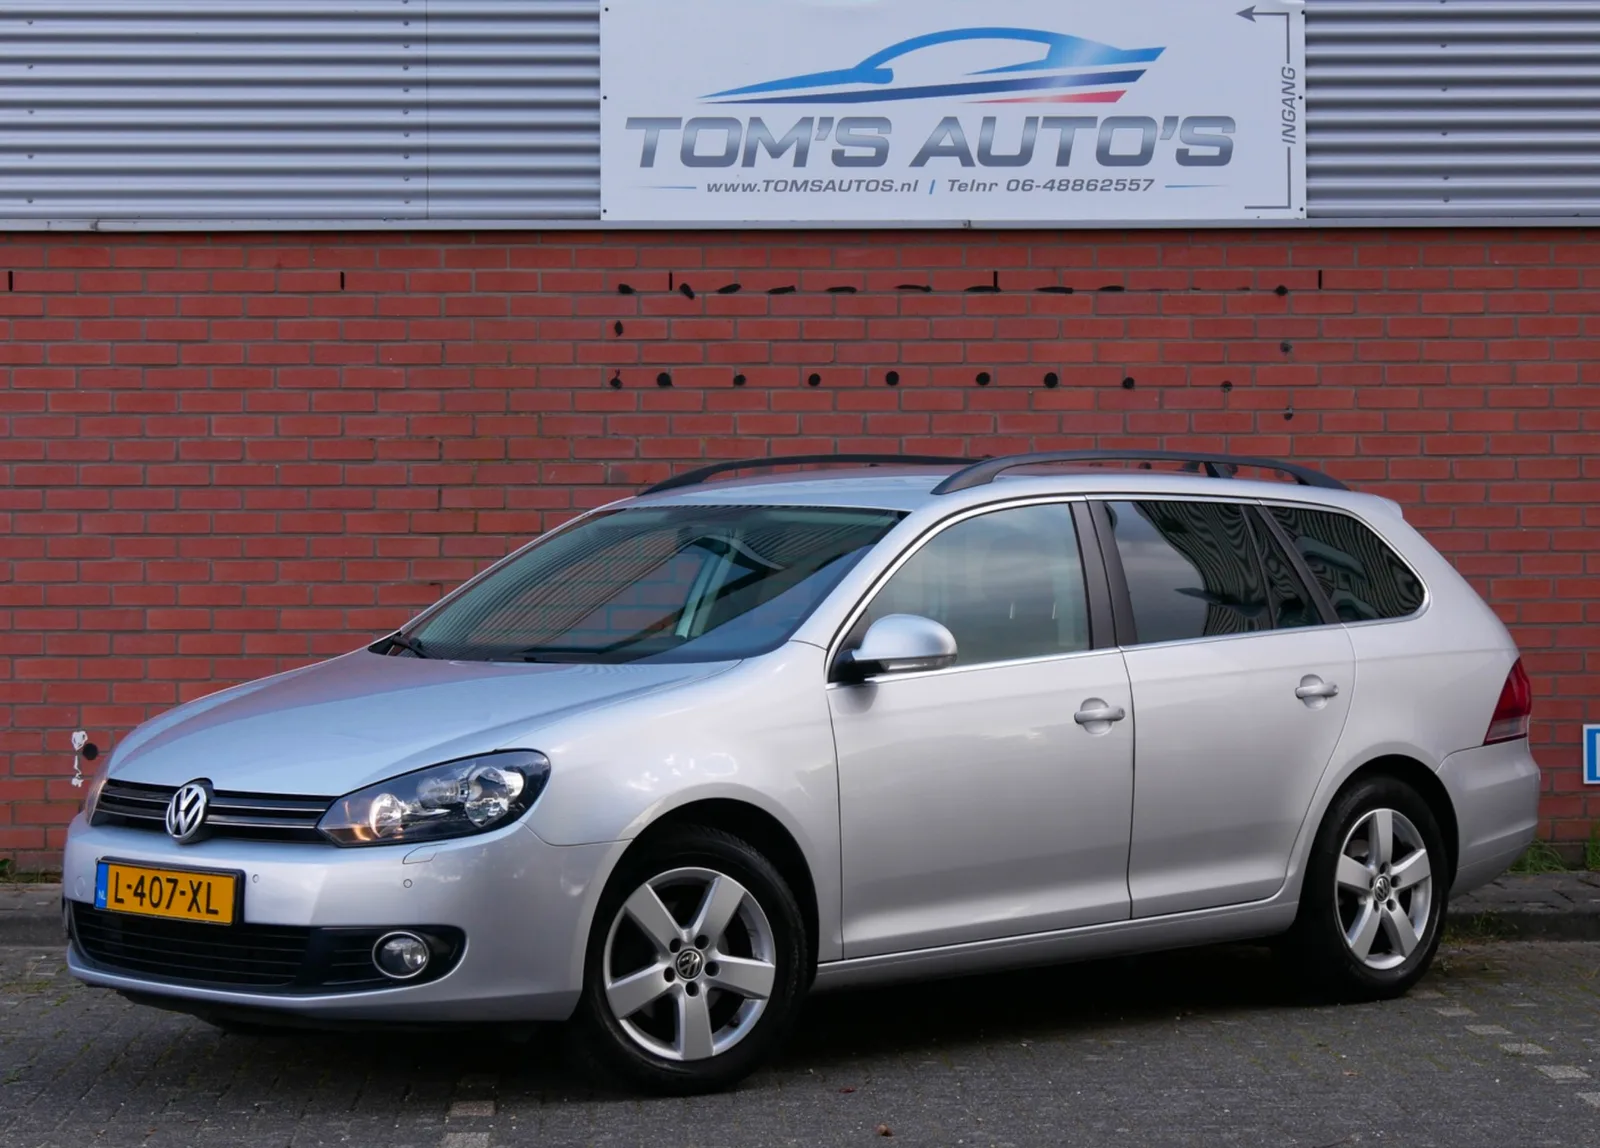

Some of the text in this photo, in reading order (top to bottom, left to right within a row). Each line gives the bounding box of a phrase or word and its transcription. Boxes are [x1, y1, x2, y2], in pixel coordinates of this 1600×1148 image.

[1281, 66, 1296, 145] INGANG
[625, 115, 1237, 168] TOM'S AUTO'S
[706, 178, 1155, 193] www.TOMSAUTOS.nl Telnr 06-48862557
[114, 872, 219, 916] L-407-XL
